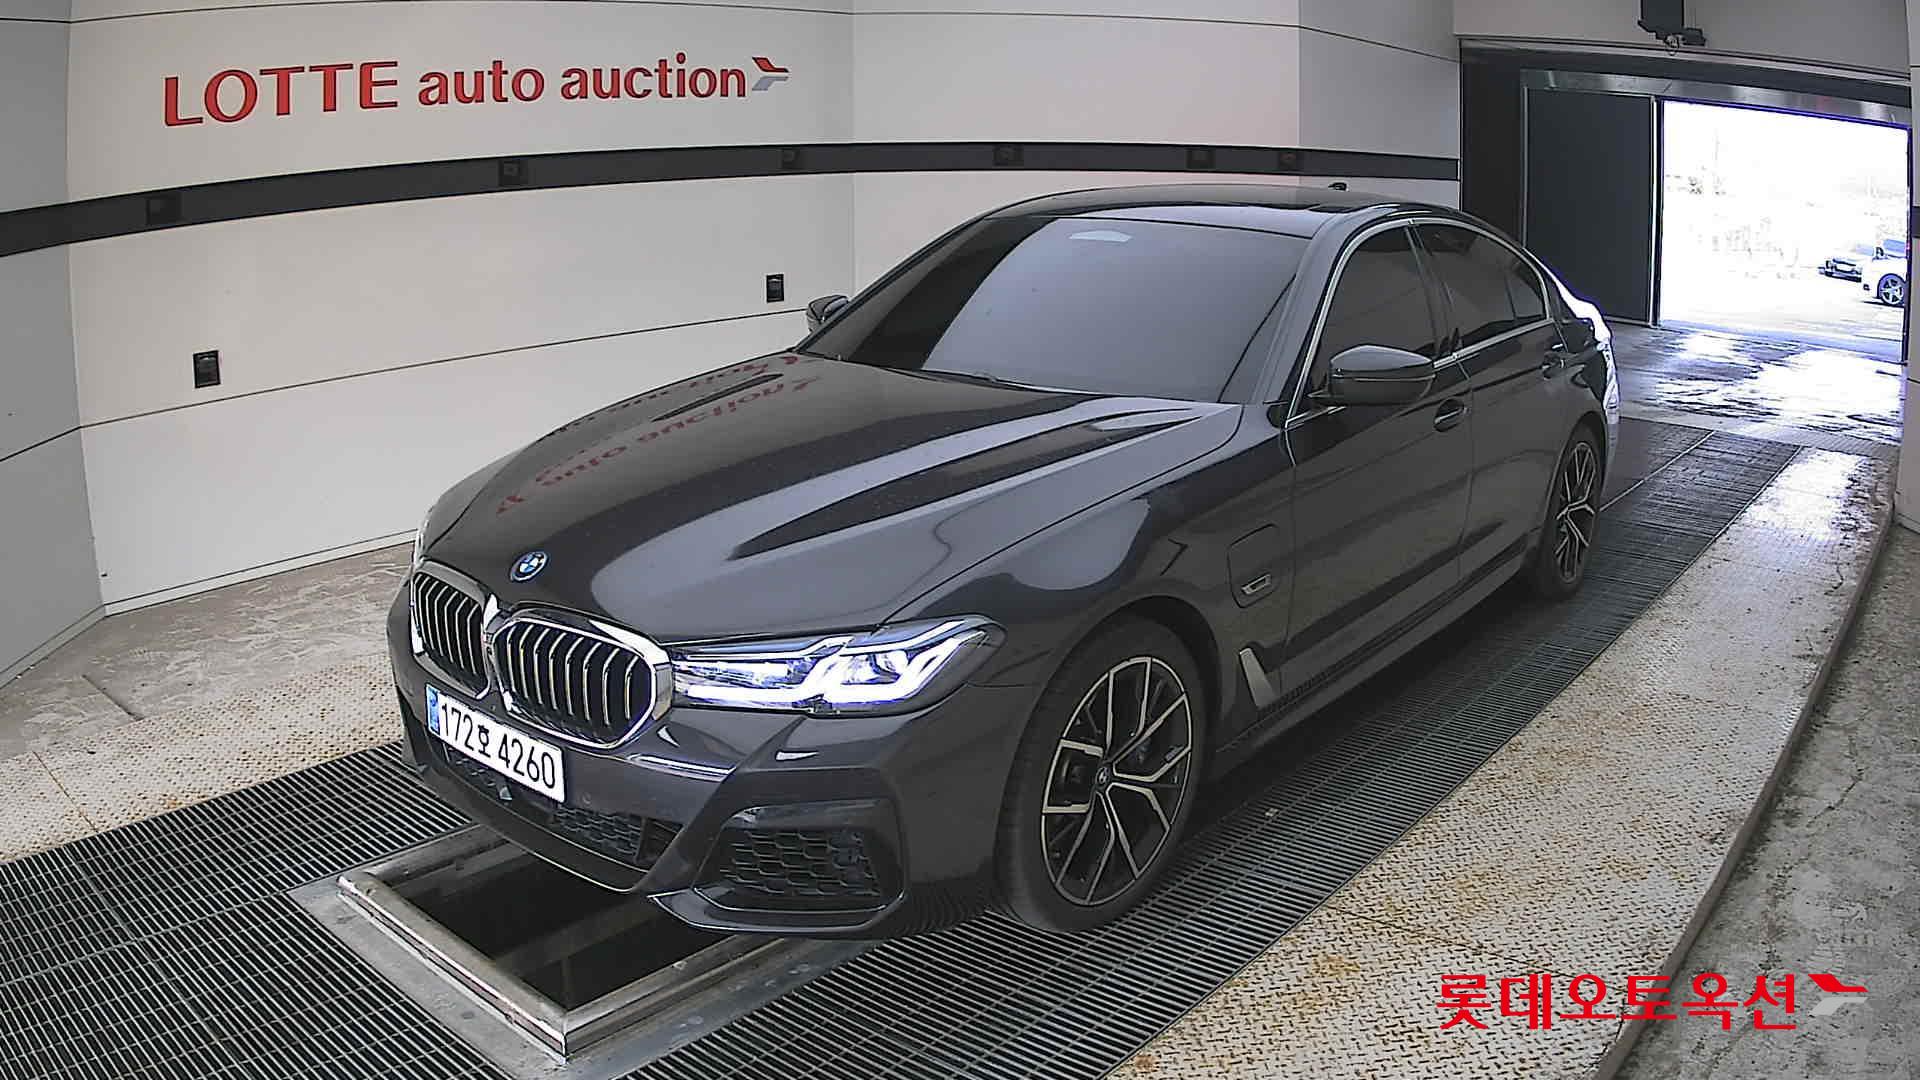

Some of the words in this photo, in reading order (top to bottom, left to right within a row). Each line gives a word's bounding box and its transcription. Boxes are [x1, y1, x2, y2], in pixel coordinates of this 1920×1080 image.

[164, 60, 399, 127] LOTTE
[417, 59, 546, 106] auto
[560, 52, 747, 100] auction
[441, 703, 492, 759] 172호
[498, 733, 556, 789] 4260
